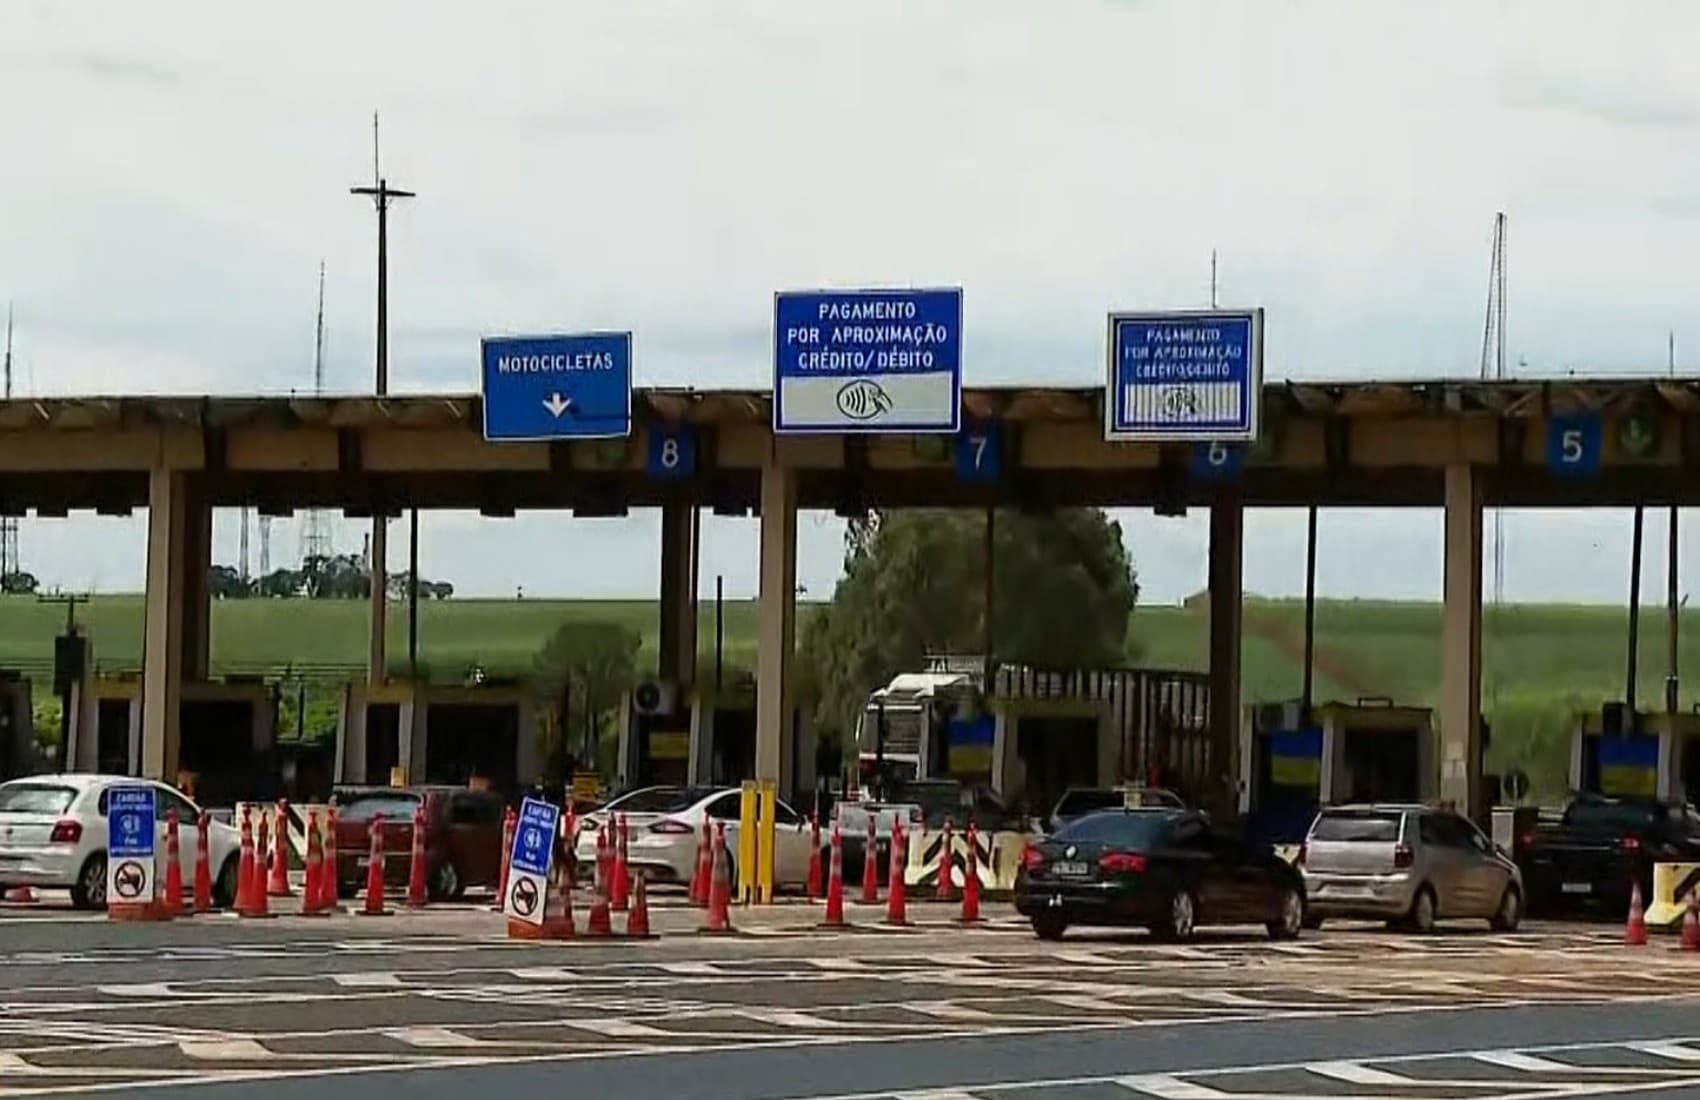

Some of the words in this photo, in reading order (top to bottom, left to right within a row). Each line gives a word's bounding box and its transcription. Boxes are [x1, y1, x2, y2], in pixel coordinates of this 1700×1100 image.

[819, 302, 916, 319] PAGAMENTO
[788, 328, 820, 344] POR
[832, 323, 947, 346] APROXIMAÇÃO
[498, 352, 613, 373] MOTOCICLETAS
[661, 438, 679, 468] 8
[969, 437, 987, 470] 7
[1208, 439, 1227, 466] 6
[1562, 430, 1582, 462] 5
